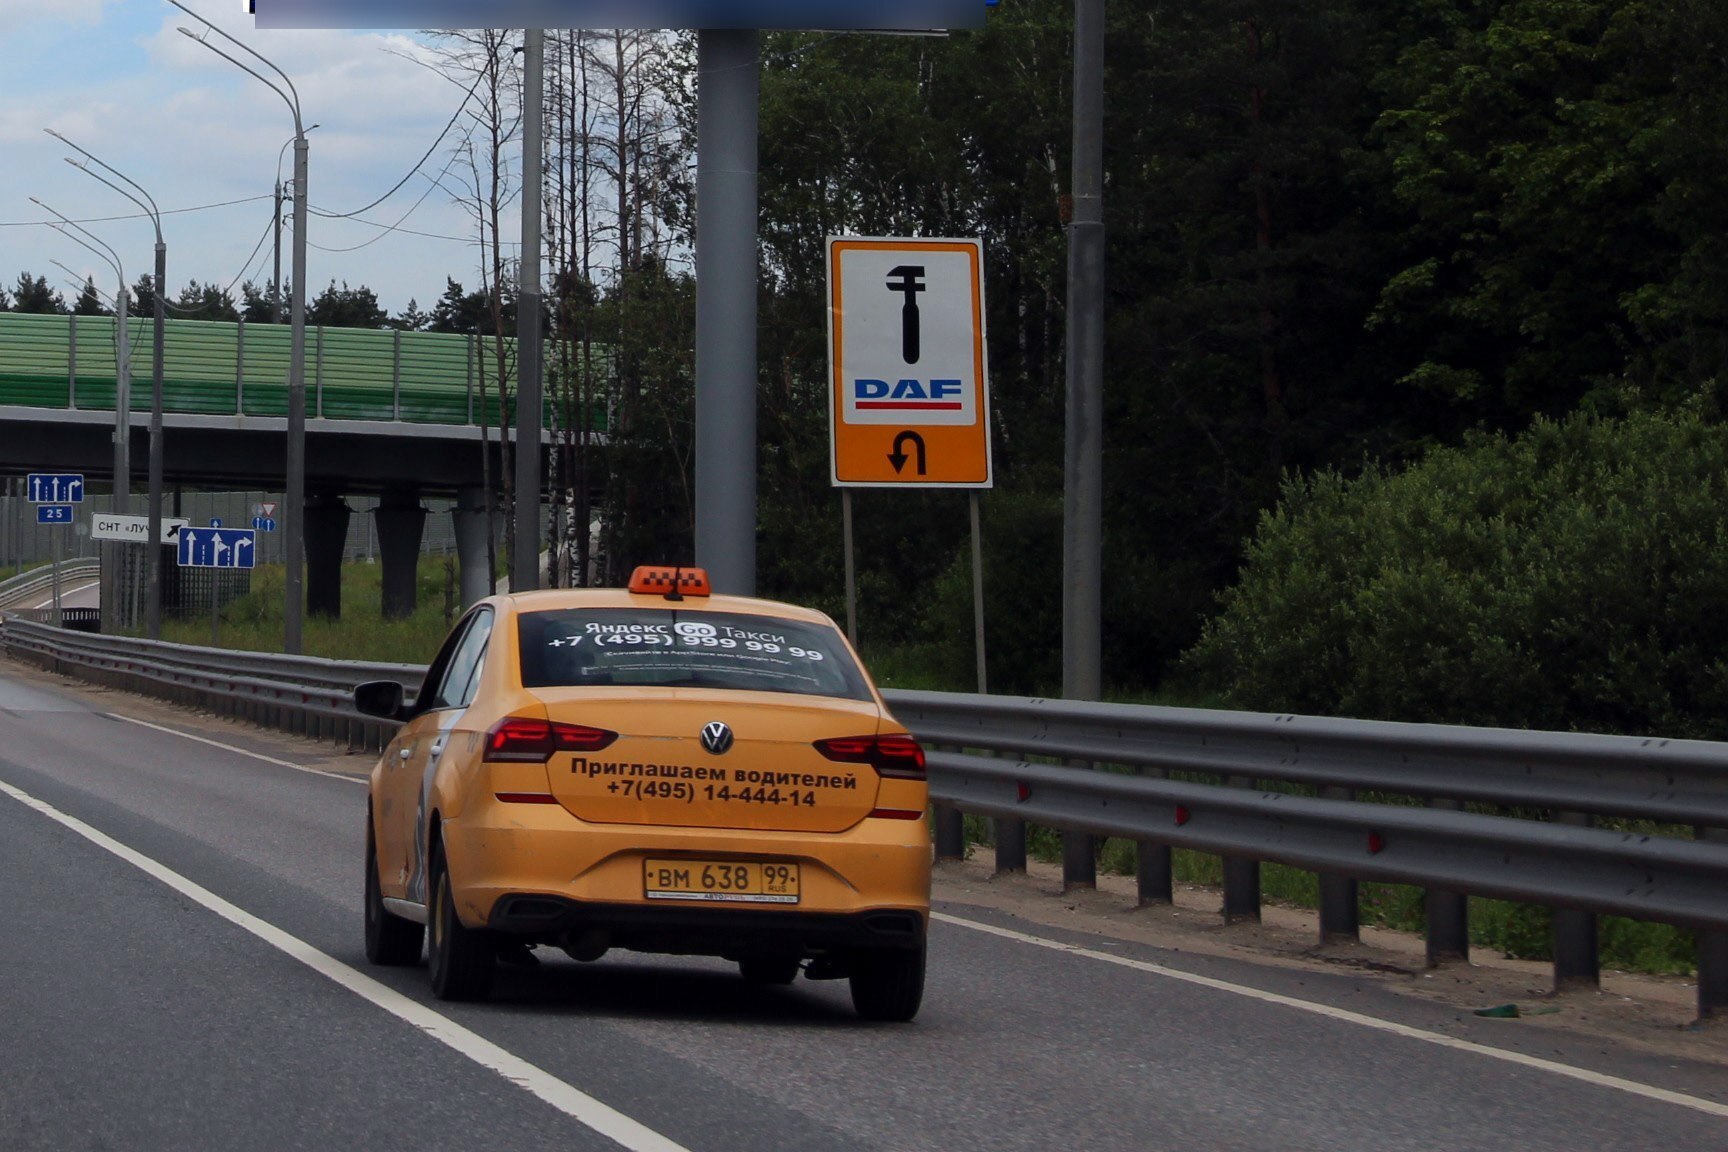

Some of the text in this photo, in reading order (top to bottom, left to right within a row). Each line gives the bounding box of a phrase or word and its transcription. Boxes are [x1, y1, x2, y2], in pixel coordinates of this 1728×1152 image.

[855, 379, 962, 399] DAF
[98, 521, 121, 532] СНТ
[585, 622, 668, 634] Яндекс
[721, 626, 785, 644] Такси
[548, 634, 824, 661] +7 (495) 999 99 99
[571, 758, 857, 791] Приглашаем водителей
[607, 779, 816, 807] +7(495) 14-444-14
[659, 865, 789, 890] ВМ 638 99
[768, 884, 786, 892] RUS
